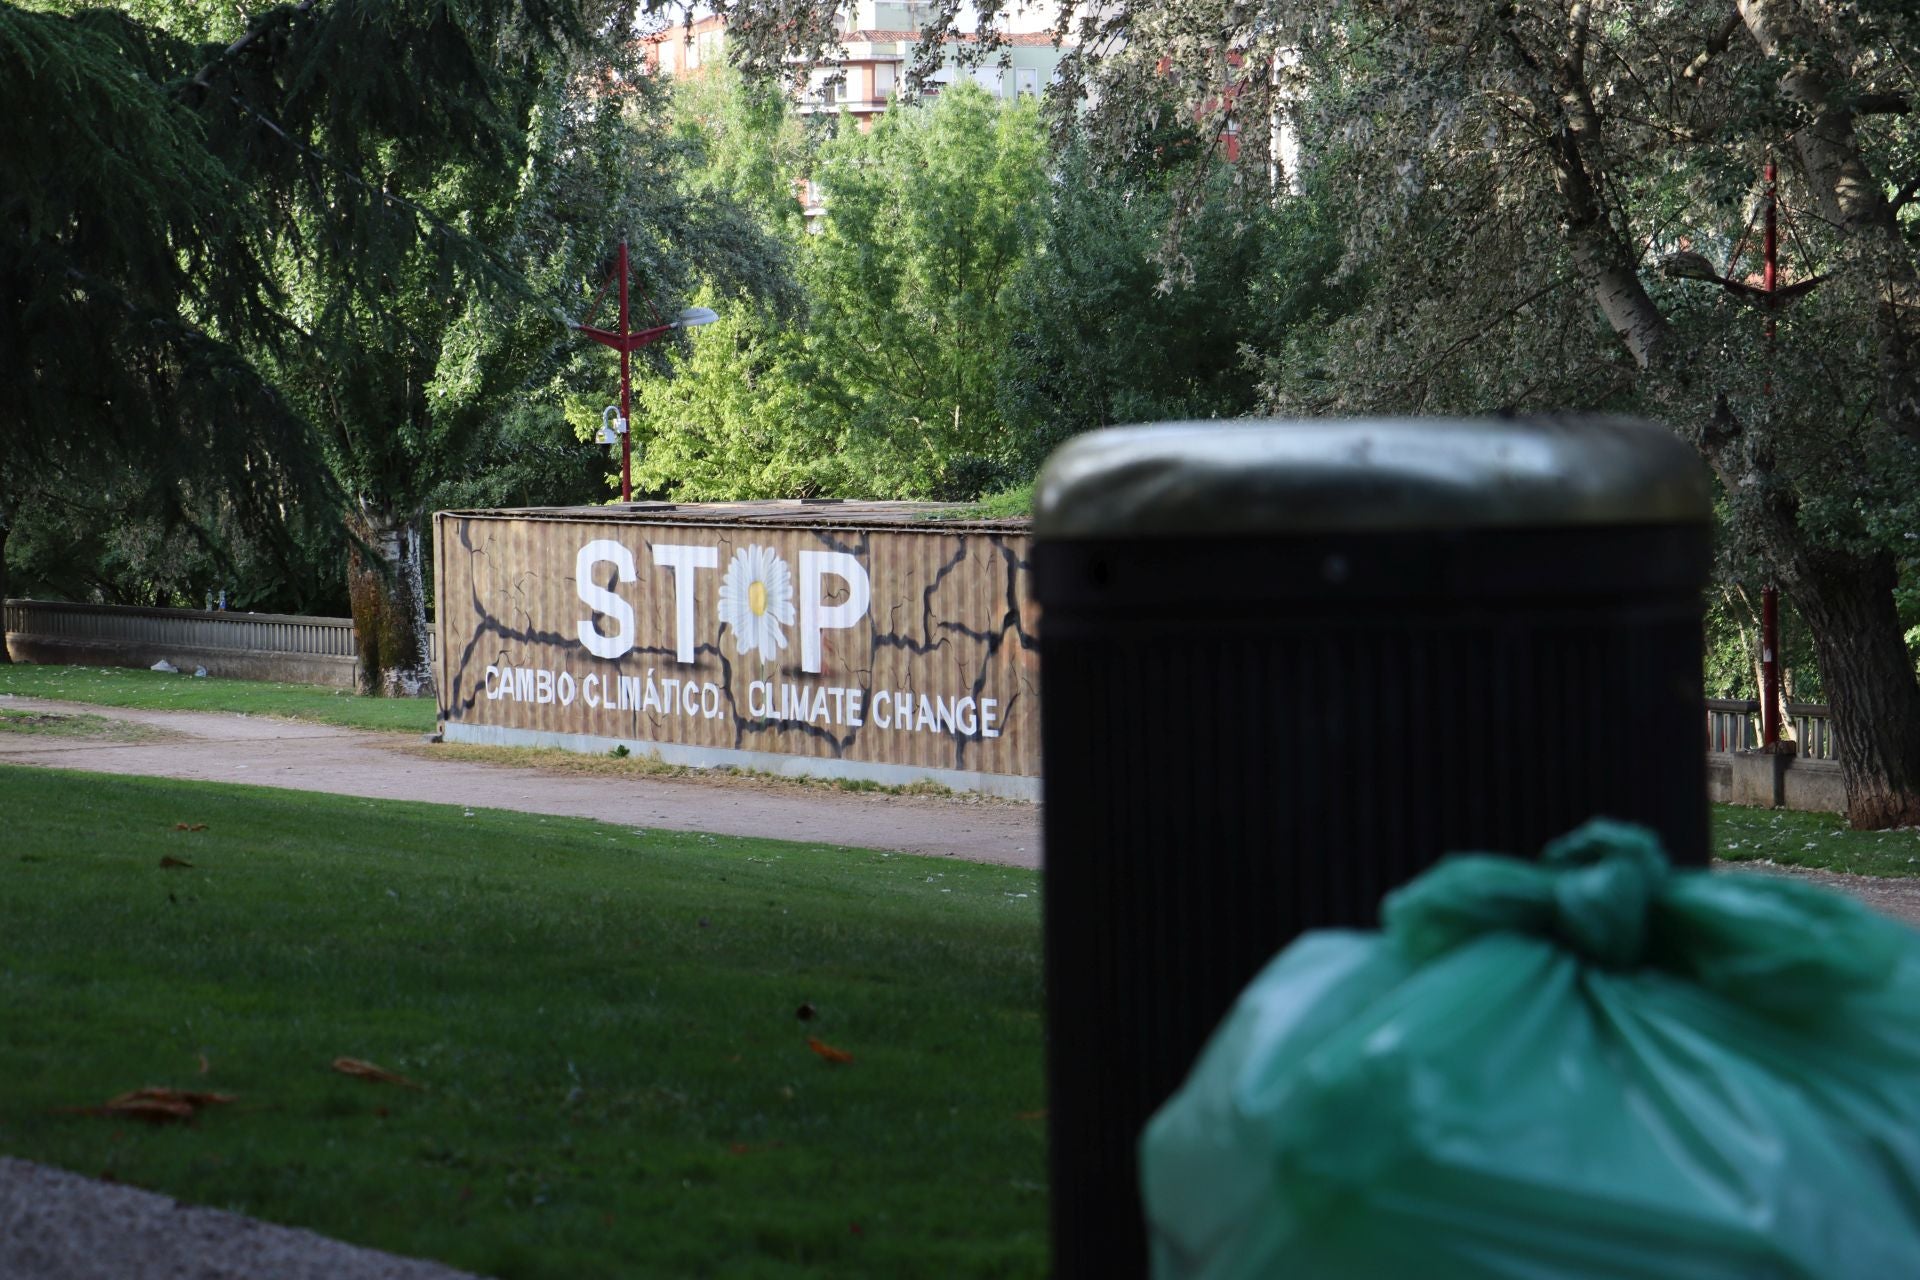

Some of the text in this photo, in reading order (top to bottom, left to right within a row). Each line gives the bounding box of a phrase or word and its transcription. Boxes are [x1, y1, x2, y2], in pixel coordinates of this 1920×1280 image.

[576, 539, 870, 674] STOP
[485, 665, 1000, 738] CAMBIO CLIMÁTICO. CLIMATE CHANGE
